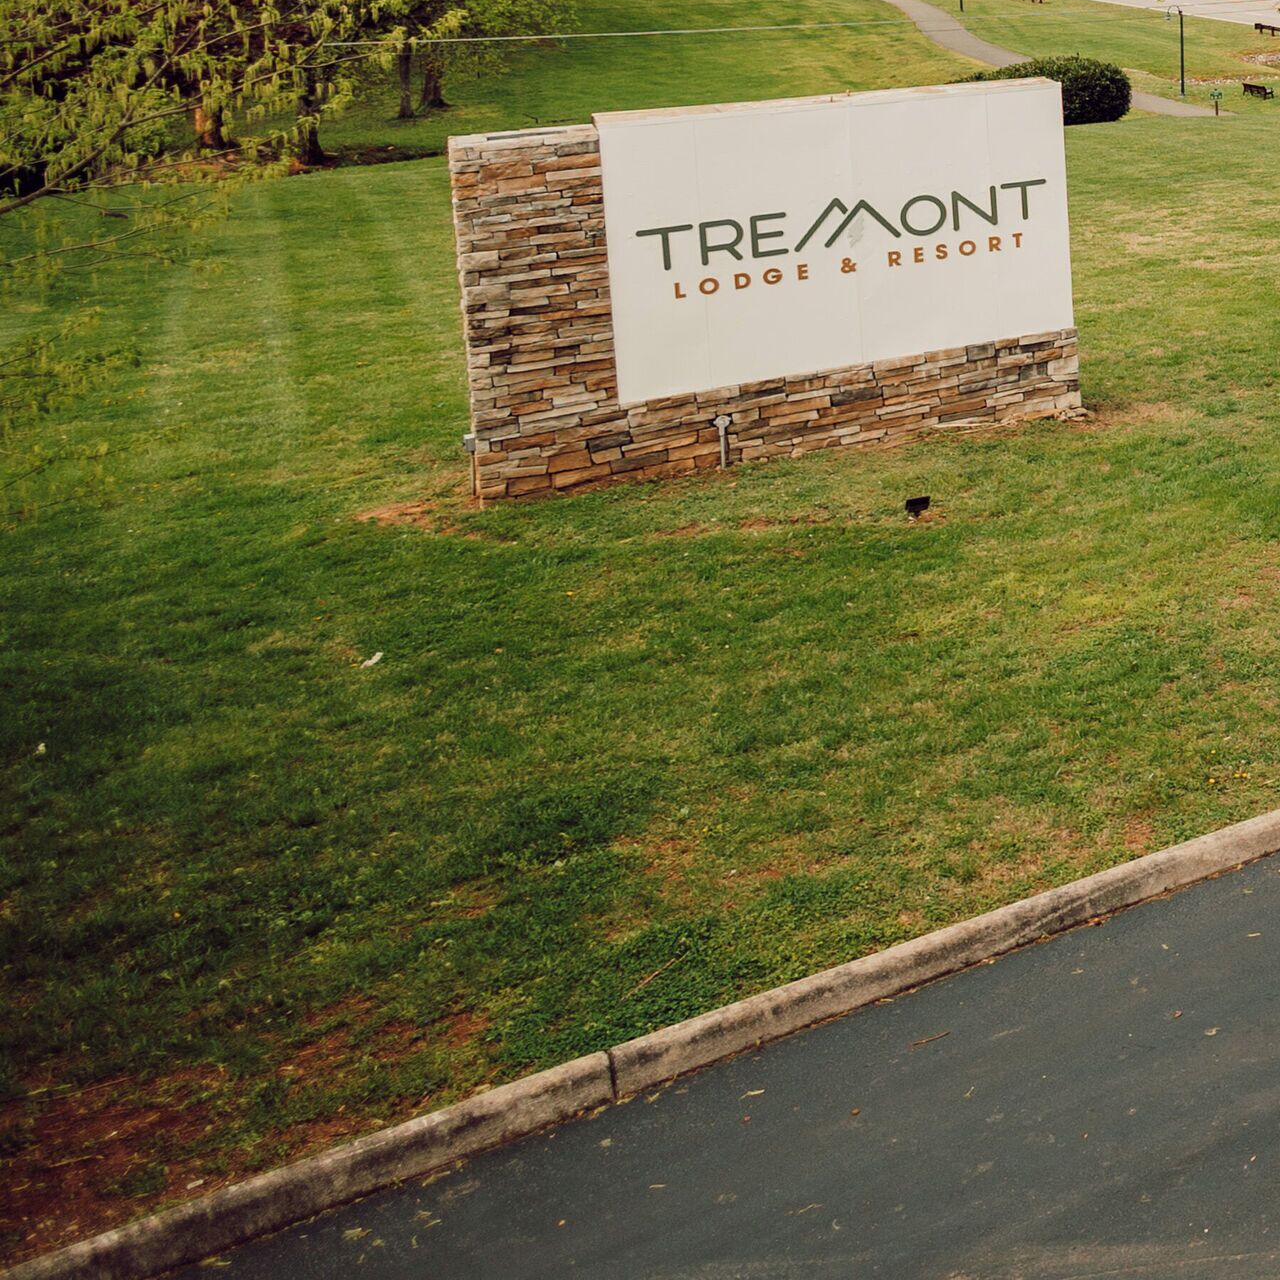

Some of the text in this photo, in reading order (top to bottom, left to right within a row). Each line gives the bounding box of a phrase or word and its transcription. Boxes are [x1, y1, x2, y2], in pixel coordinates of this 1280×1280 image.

[635, 179, 1046, 271] TREMONT
[673, 232, 1023, 300] LODGE & RESORT
